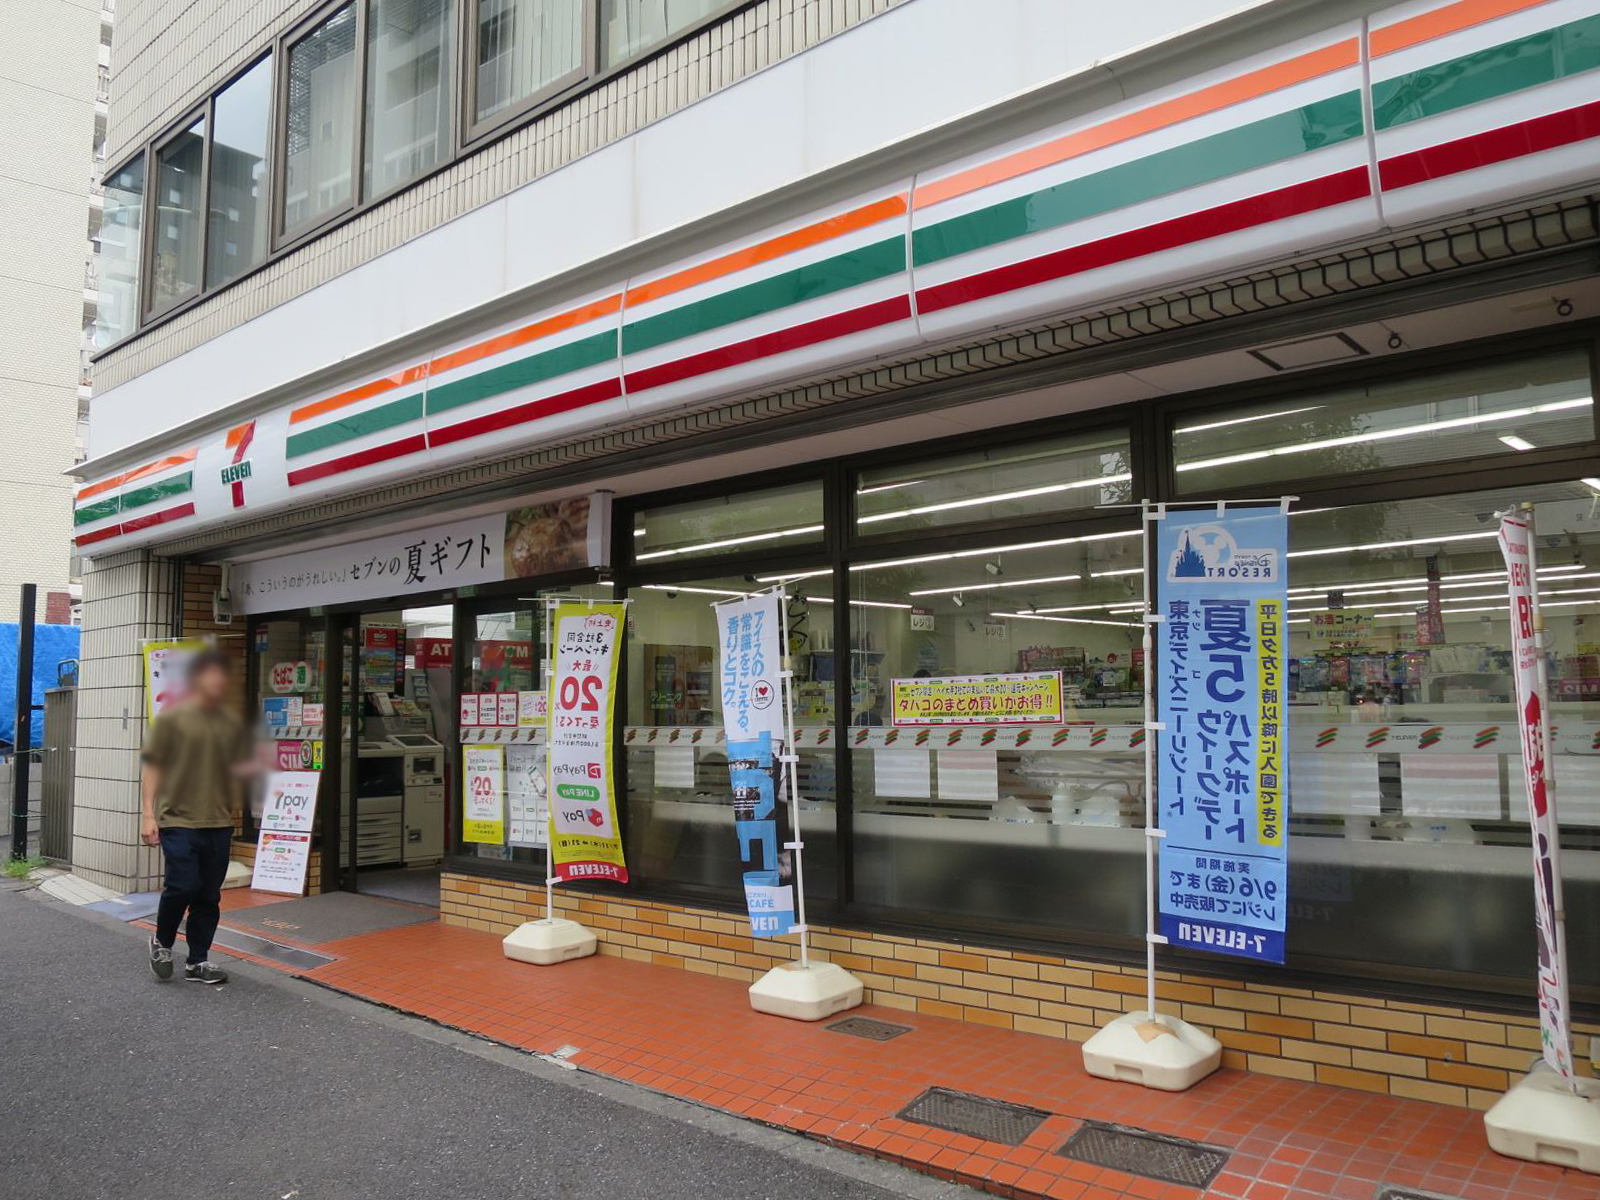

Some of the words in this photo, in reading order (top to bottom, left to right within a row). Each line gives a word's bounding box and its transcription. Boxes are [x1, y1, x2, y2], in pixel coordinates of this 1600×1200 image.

[224, 420, 256, 508] 7
[350, 533, 491, 585] セブンの夏ギフト
[430, 643, 453, 656] AT
[751, 610, 765, 677] アイスの
